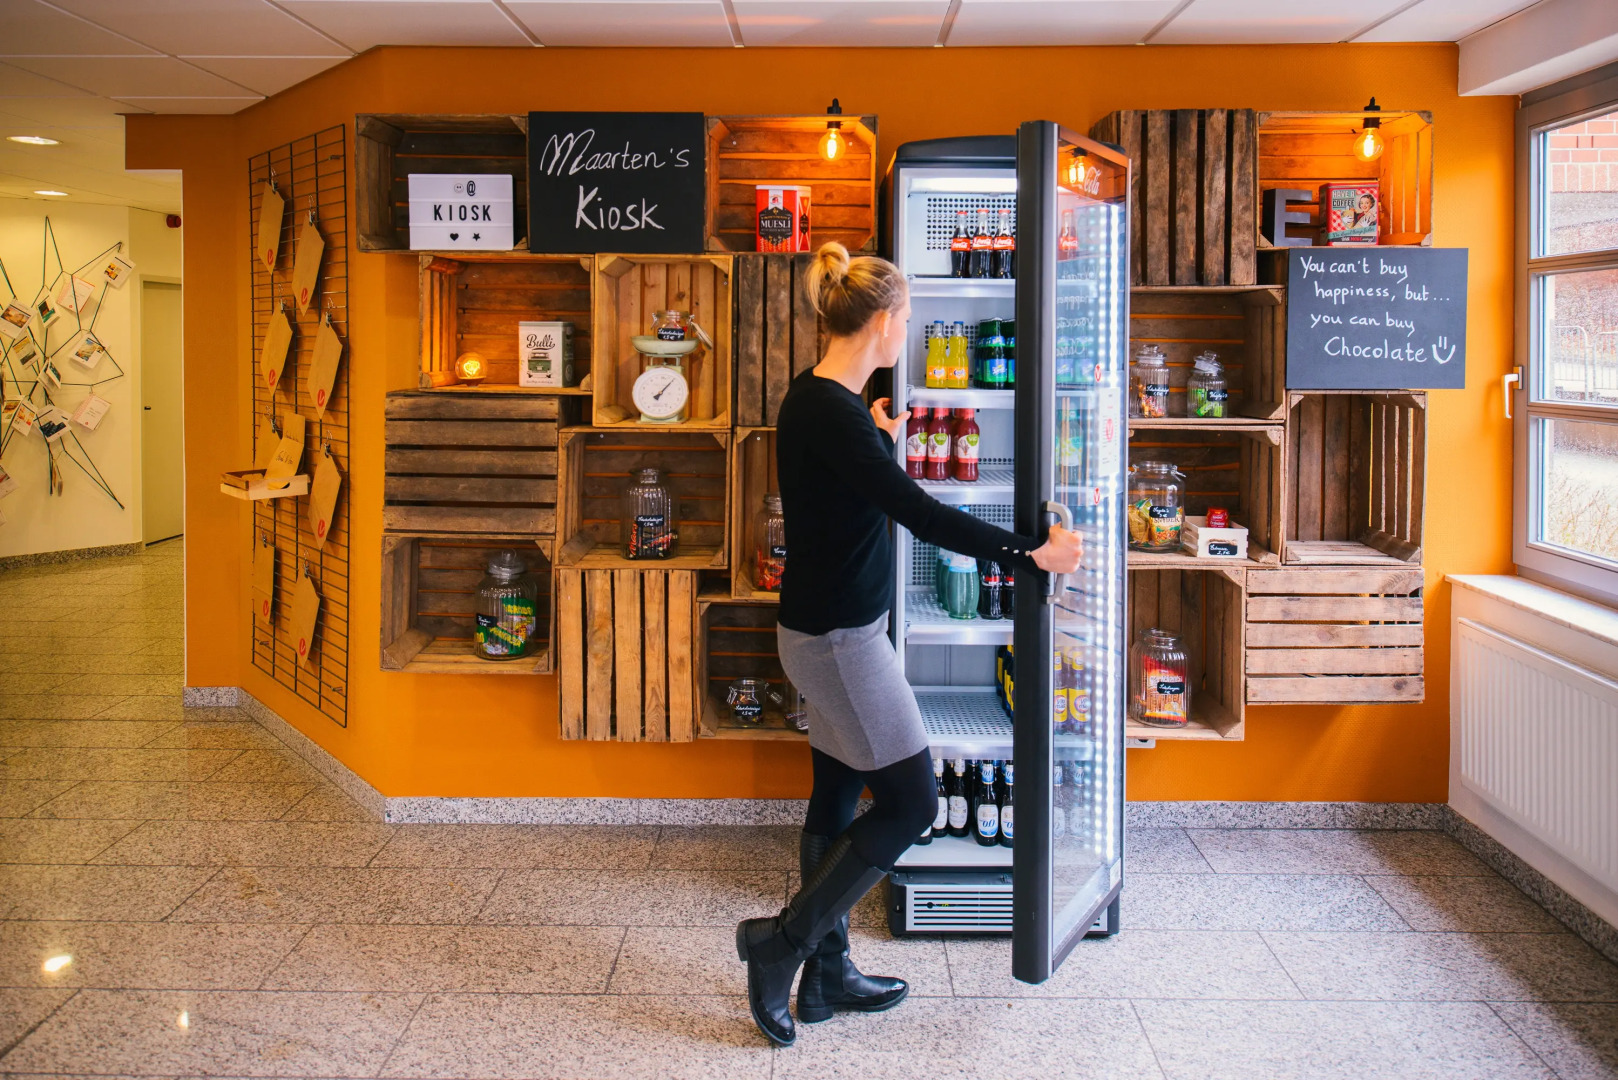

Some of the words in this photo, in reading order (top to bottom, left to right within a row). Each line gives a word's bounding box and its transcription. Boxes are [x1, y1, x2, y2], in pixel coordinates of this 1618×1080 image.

[539, 128, 691, 177] Maarten's
[1332, 190, 1349, 198] HAVE
[1351, 190, 1355, 198] A
[1332, 200, 1355, 208] COFFEE
[433, 204, 492, 222] KIOSK
[575, 184, 666, 231] Kiosk
[1271, 188, 1313, 247] E
[760, 219, 791, 229] MUESLI
[1300, 256, 1325, 279] You
[1329, 257, 1370, 274] can't
[1380, 258, 1408, 284] buy
[1314, 281, 1396, 305] happiness,
[1310, 313, 1343, 329] you
[1349, 315, 1381, 326] can
[1385, 311, 1416, 338] buy
[526, 333, 556, 350] Bulli
[1324, 336, 1428, 363] Chocolate
